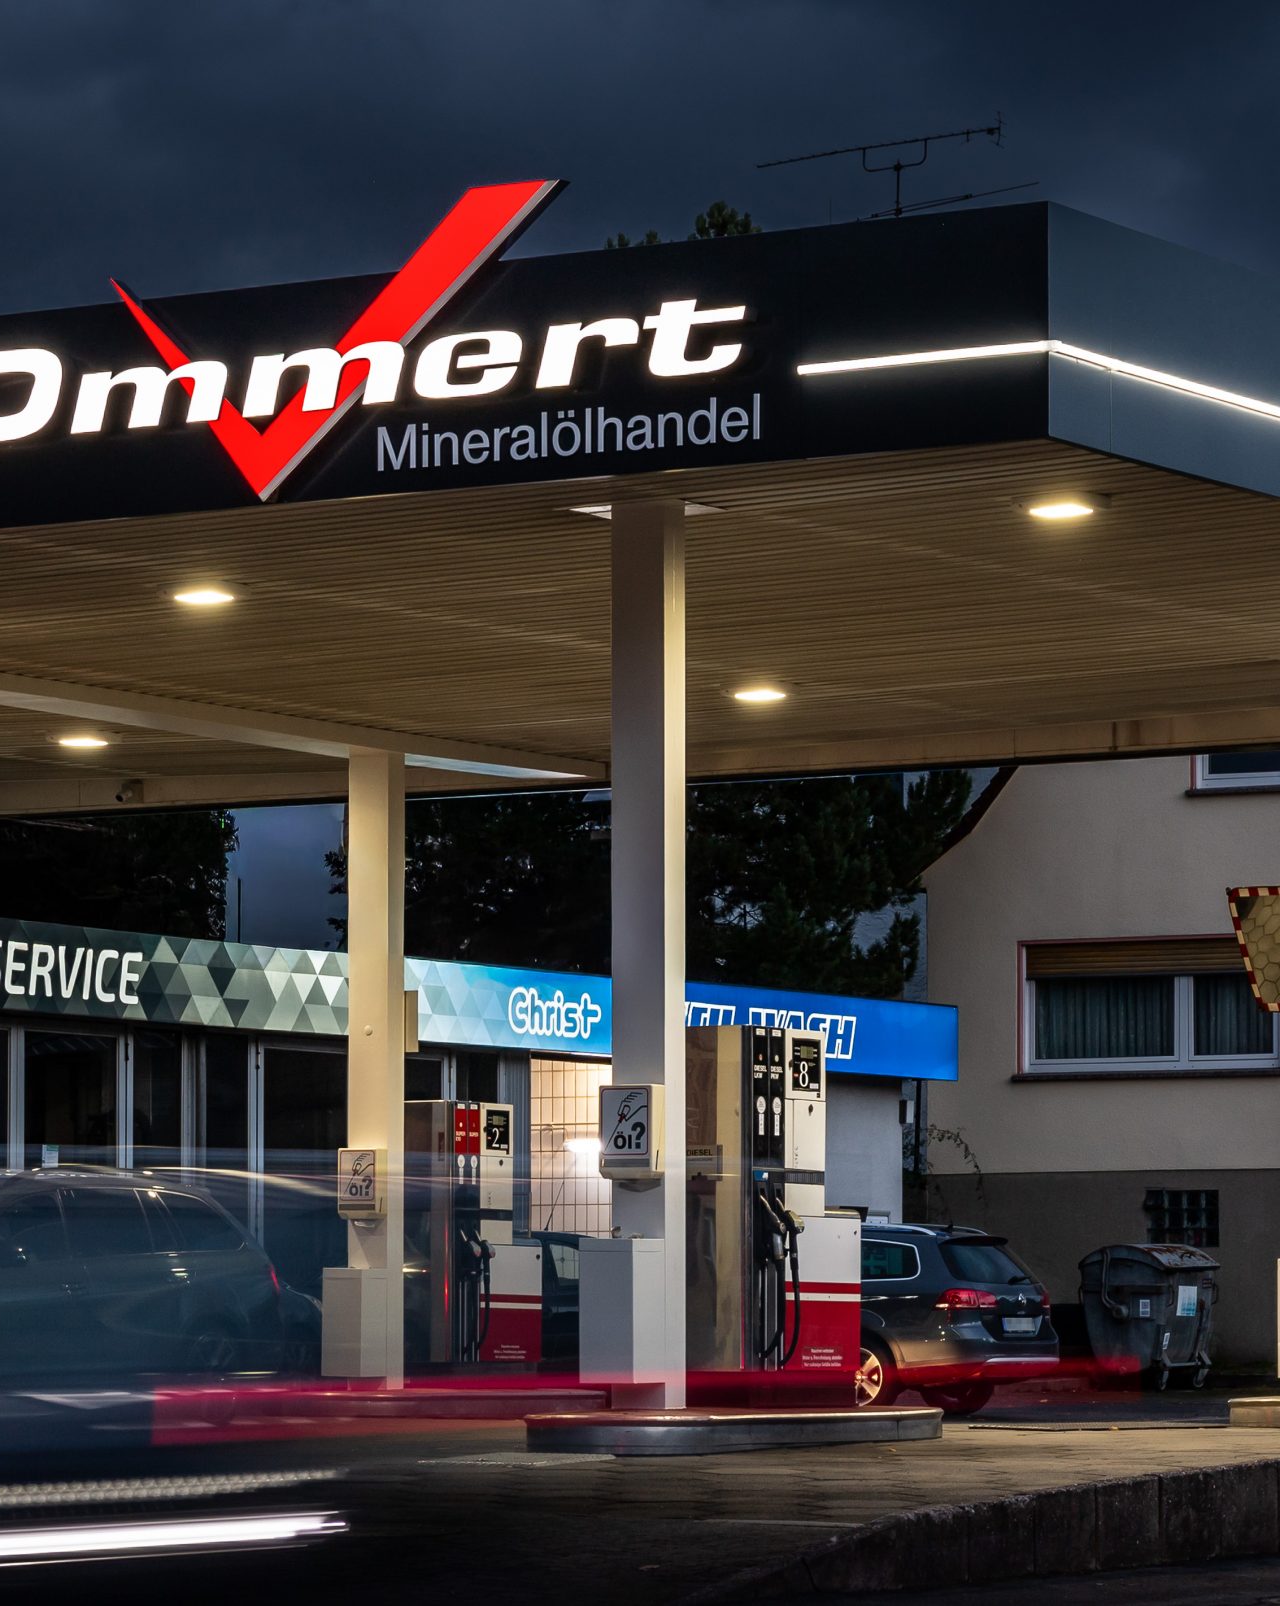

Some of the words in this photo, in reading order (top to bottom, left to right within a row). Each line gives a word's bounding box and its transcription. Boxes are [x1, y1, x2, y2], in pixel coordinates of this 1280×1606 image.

[376, 392, 762, 473] Mineralölhandel
[508, 986, 602, 1040] Christ
[799, 1061, 808, 1087] 8
[492, 1128, 499, 1147] 2
[613, 1121, 646, 1150] Öl?
[348, 1176, 373, 1197] Öl?
